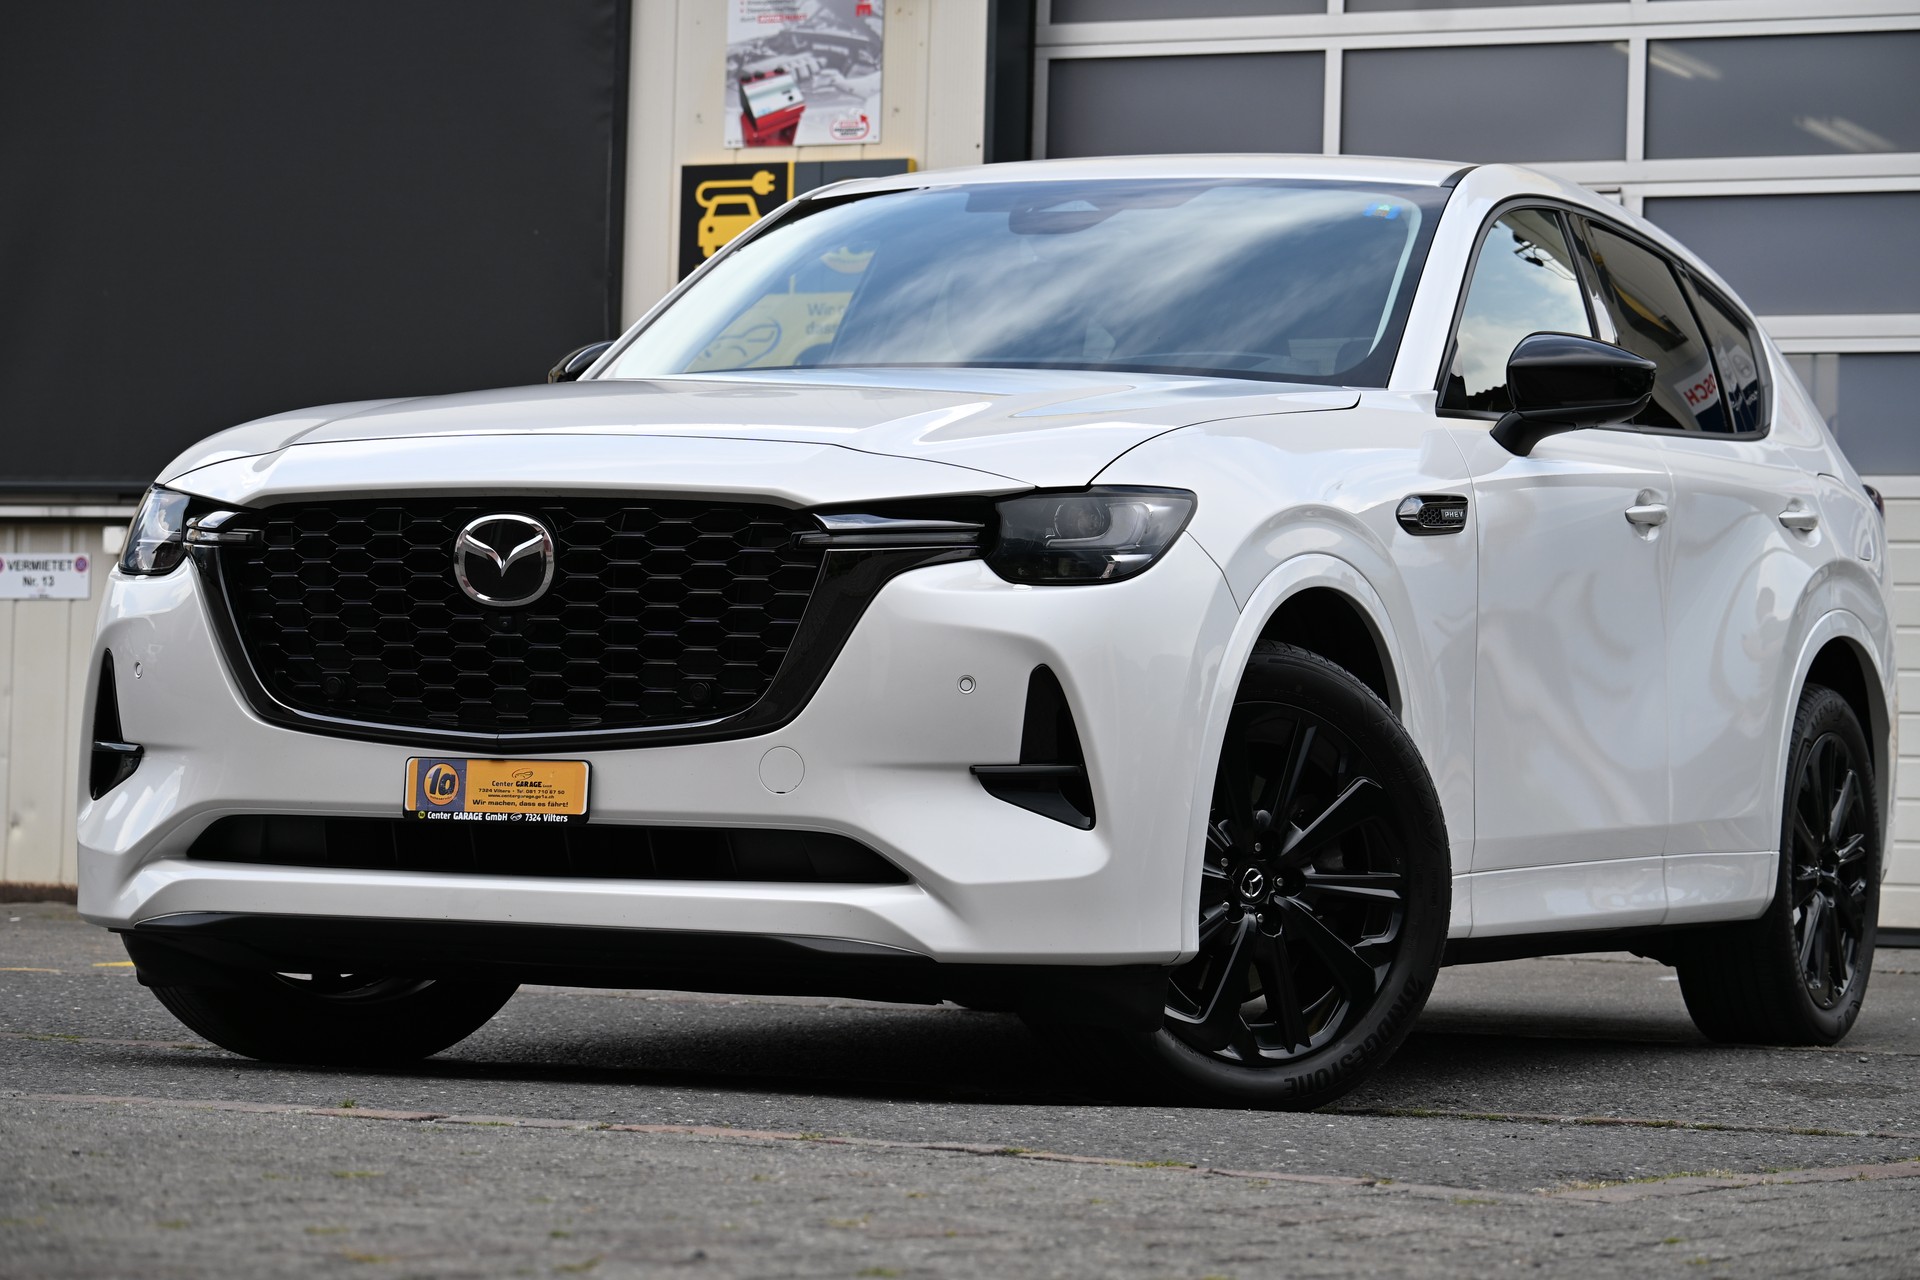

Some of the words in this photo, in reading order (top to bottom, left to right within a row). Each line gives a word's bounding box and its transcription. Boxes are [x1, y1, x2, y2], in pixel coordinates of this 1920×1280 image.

[807, 302, 834, 316] Wir
[7, 559, 72, 572] VERMIETET
[23, 575, 39, 587] Nr.
[427, 811, 451, 820] Center
[453, 812, 483, 821] GARAGE
[485, 812, 508, 821] GmbH
[525, 813, 541, 822] 7324
[543, 813, 568, 822] Vilters
[1284, 972, 1425, 1096] BRIDGESTONE
